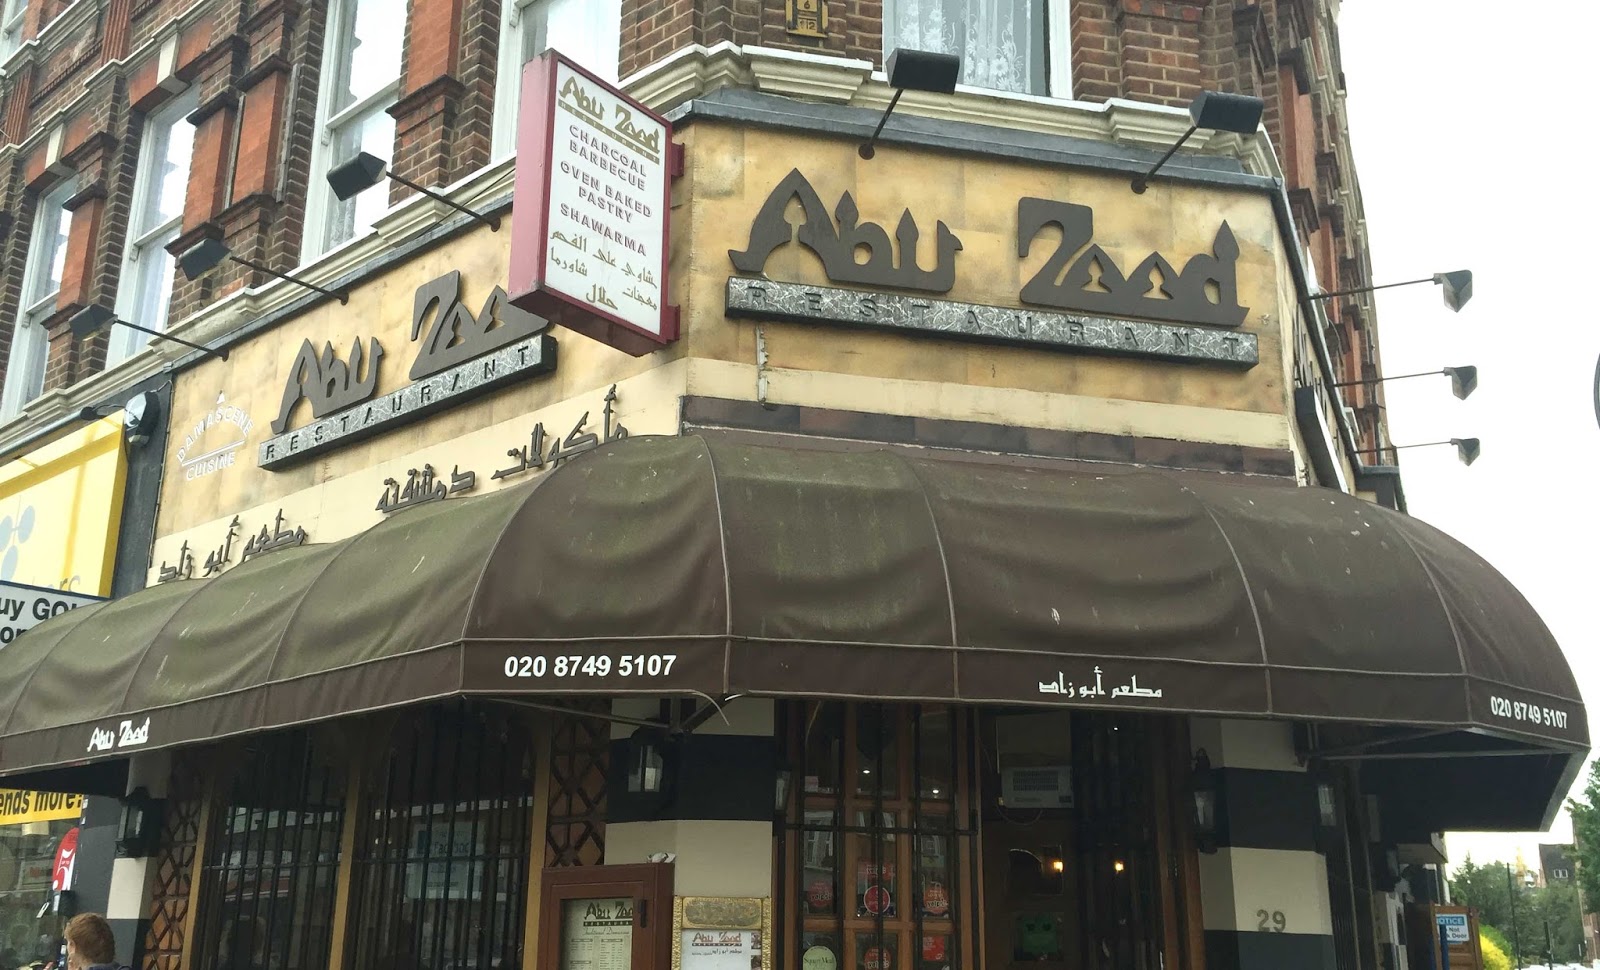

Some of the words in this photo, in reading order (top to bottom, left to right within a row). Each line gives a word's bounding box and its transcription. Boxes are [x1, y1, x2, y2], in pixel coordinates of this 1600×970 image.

[560, 101, 657, 163] RESTAURANT
[569, 124, 647, 177] CHARCOAL
[569, 141, 646, 191] BARBECUE
[560, 160, 600, 192] OVEN
[605, 186, 652, 218] BAKED
[579, 186, 633, 224] PASTRY
[550, 230, 587, 253] الفحم
[560, 202, 647, 257] SHAWARMA
[550, 247, 588, 277] شاورما
[586, 283, 618, 310] حلال
[409, 269, 549, 382] Zaa
[746, 286, 1244, 358] RESTAURANT
[266, 345, 531, 461] RESTAURANT
[176, 404, 254, 463] DAMASCENE
[186, 451, 236, 482] CUISINE
[504, 656, 547, 677] 020
[553, 655, 612, 677] 8749
[618, 655, 677, 677] 5107
[1111, 675, 1163, 699] مطعم
[1490, 696, 1512, 719] 020
[1514, 701, 1542, 725] 8749
[1543, 707, 1568, 730] 5107
[1256, 909, 1286, 933] 29
